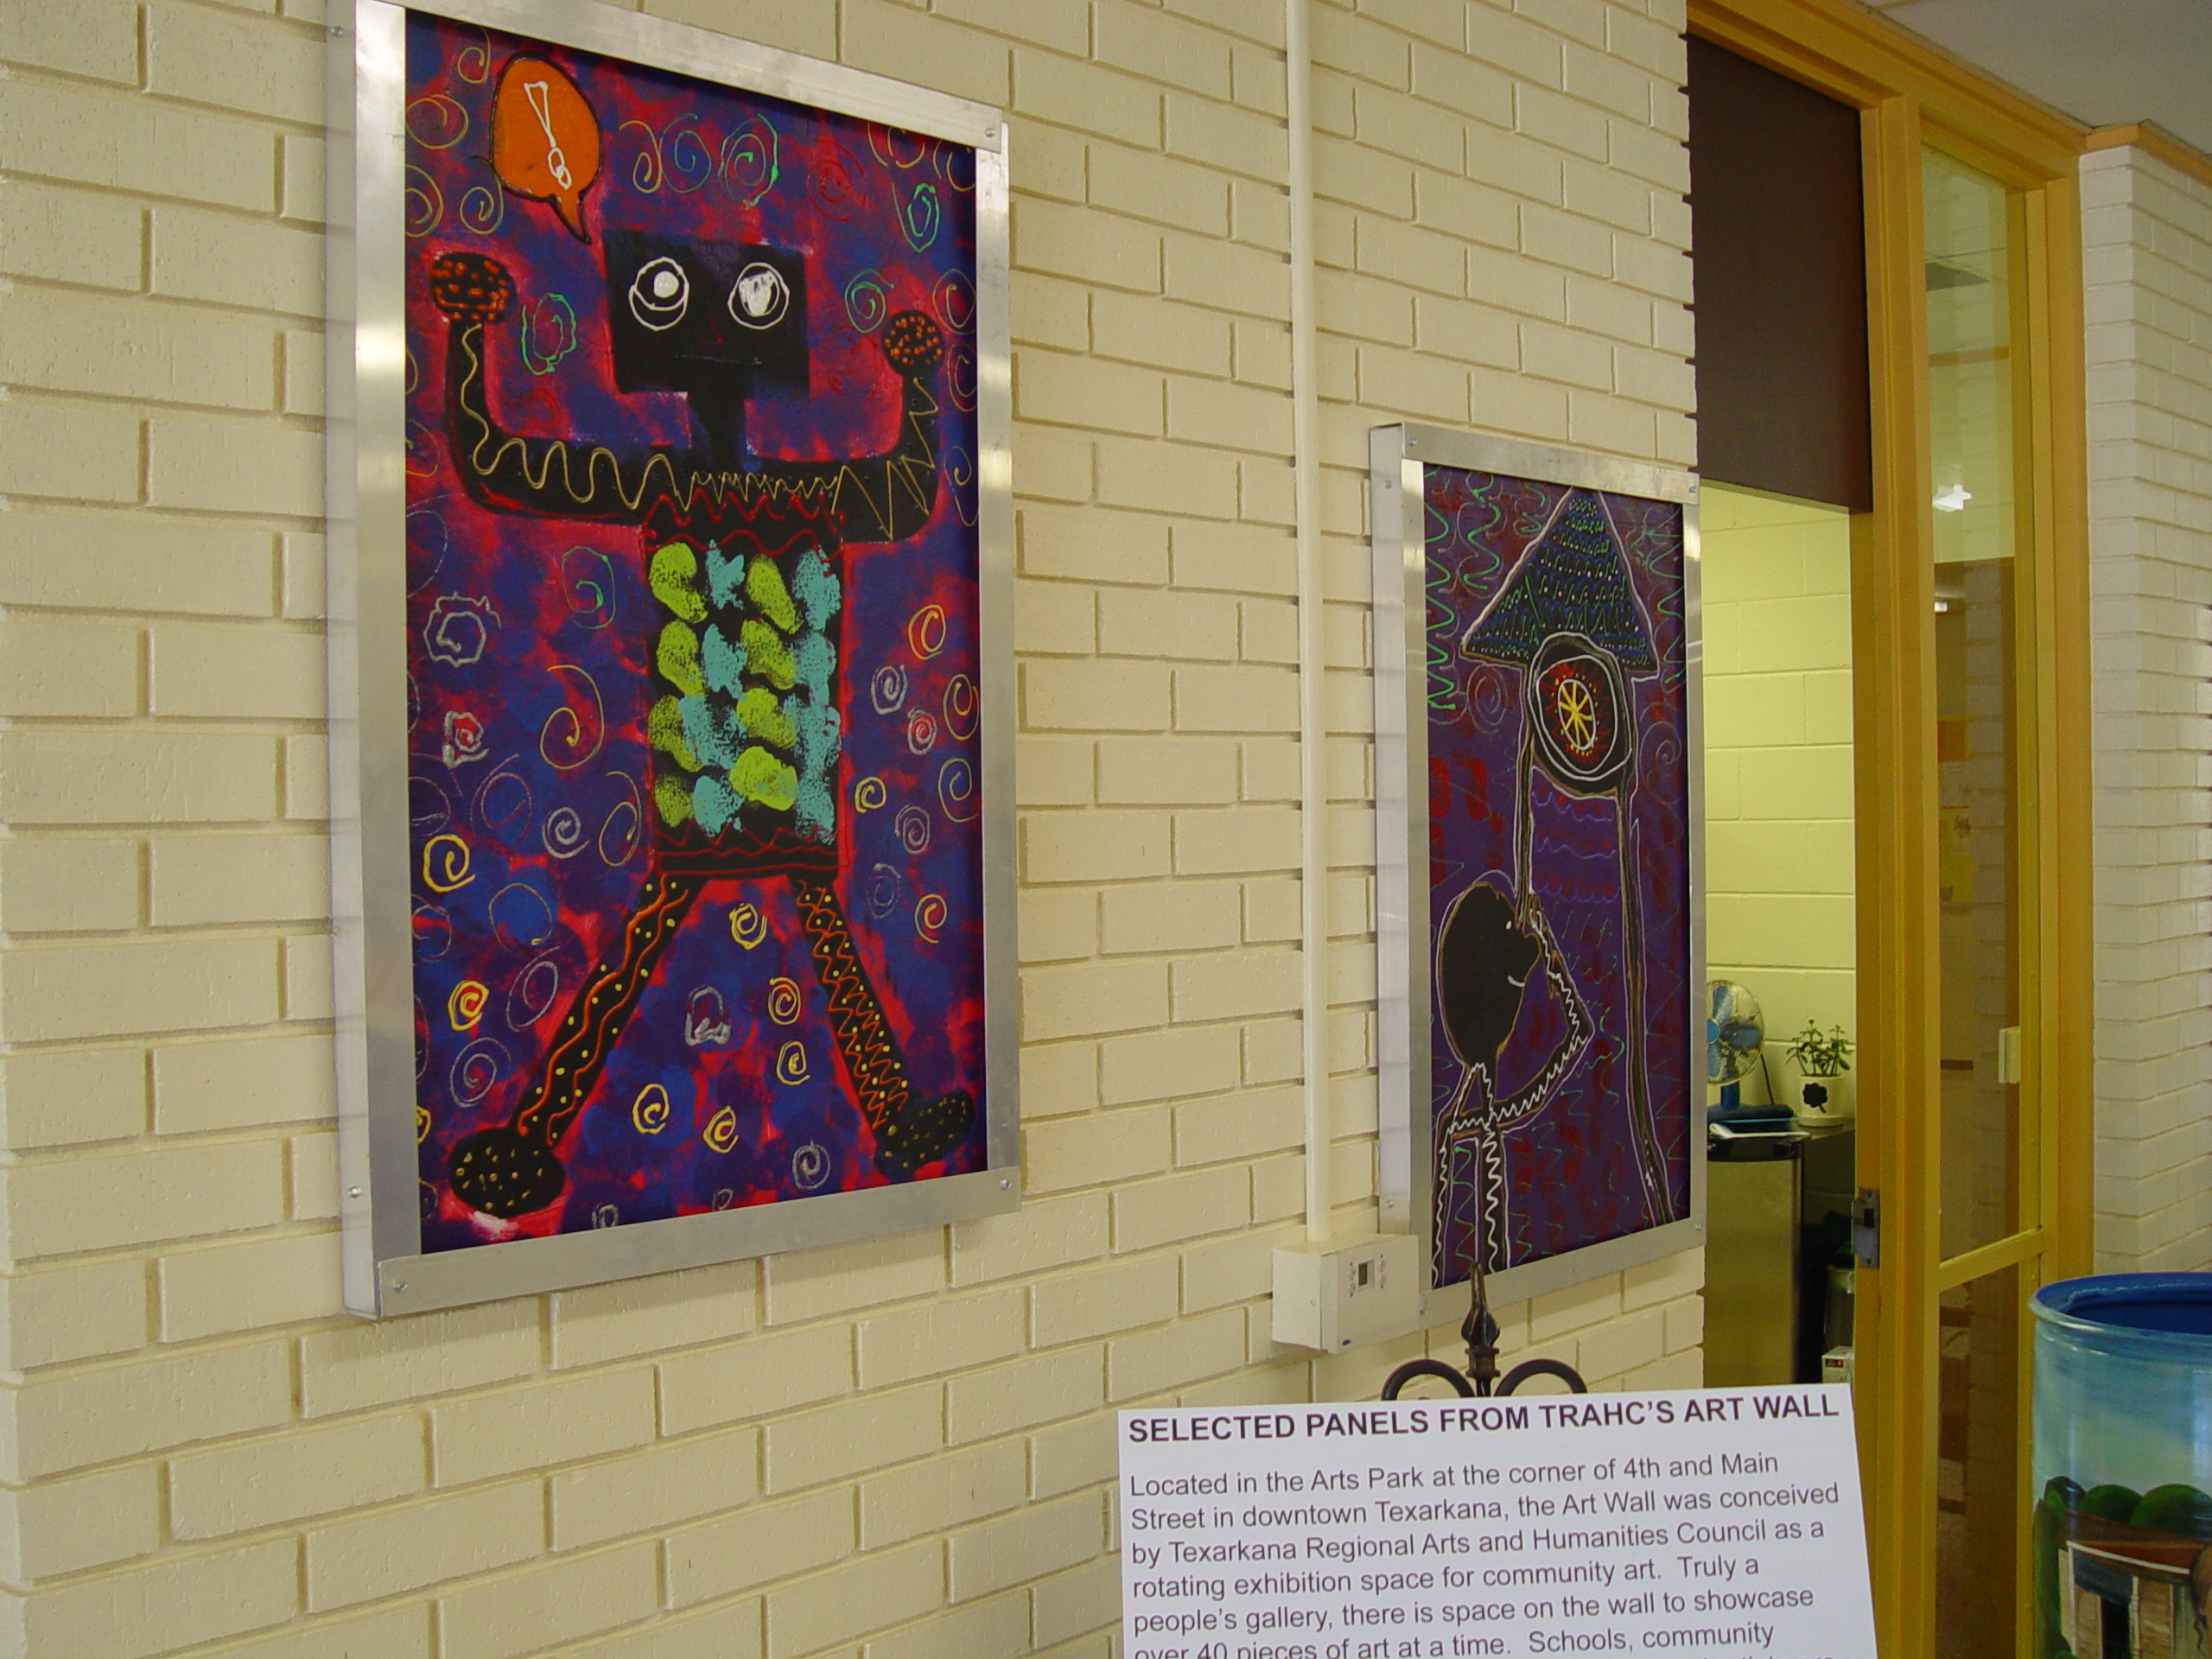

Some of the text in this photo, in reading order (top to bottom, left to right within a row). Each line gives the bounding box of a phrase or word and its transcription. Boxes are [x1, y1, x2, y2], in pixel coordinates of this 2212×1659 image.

[1128, 1414, 1295, 1443] SELECTED
[1306, 1409, 1429, 1438] PANELS
[1440, 1405, 1529, 1433] FROM
[1683, 1396, 1745, 1423] ART
[1752, 1393, 1840, 1420] WALL
[1130, 1452, 1778, 1497] Located in the Arts Park at the corner of 4th and Main
[1131, 1481, 1839, 1530] Street in downtown Texarkana, the Art Wall was conceived
[1132, 1518, 1825, 1570] by Texarkana Regional Arts and Humanities Council as a
[1133, 1554, 1759, 1602] rotating exhibition space for community art. Truly a
[1245, 1605, 1332, 1635] gallery,
[1342, 1603, 1406, 1626] there
[1414, 1601, 1433, 1624] is
[1441, 1603, 1516, 1628] space
[1523, 1601, 1554, 1619] on
[1561, 1594, 1600, 1618] the
[1607, 1592, 1655, 1615] wall
[1662, 1591, 1686, 1613] to
[1694, 1588, 1814, 1611] showcase
[1325, 1637, 1351, 1659] of
[1357, 1637, 1390, 1659] art
[1398, 1637, 1421, 1659] at
[1429, 1640, 1444, 1657] a
[1452, 1633, 1511, 1656] time.
[1529, 1627, 1633, 1654] Schools,
[1642, 1620, 1774, 1649] community
